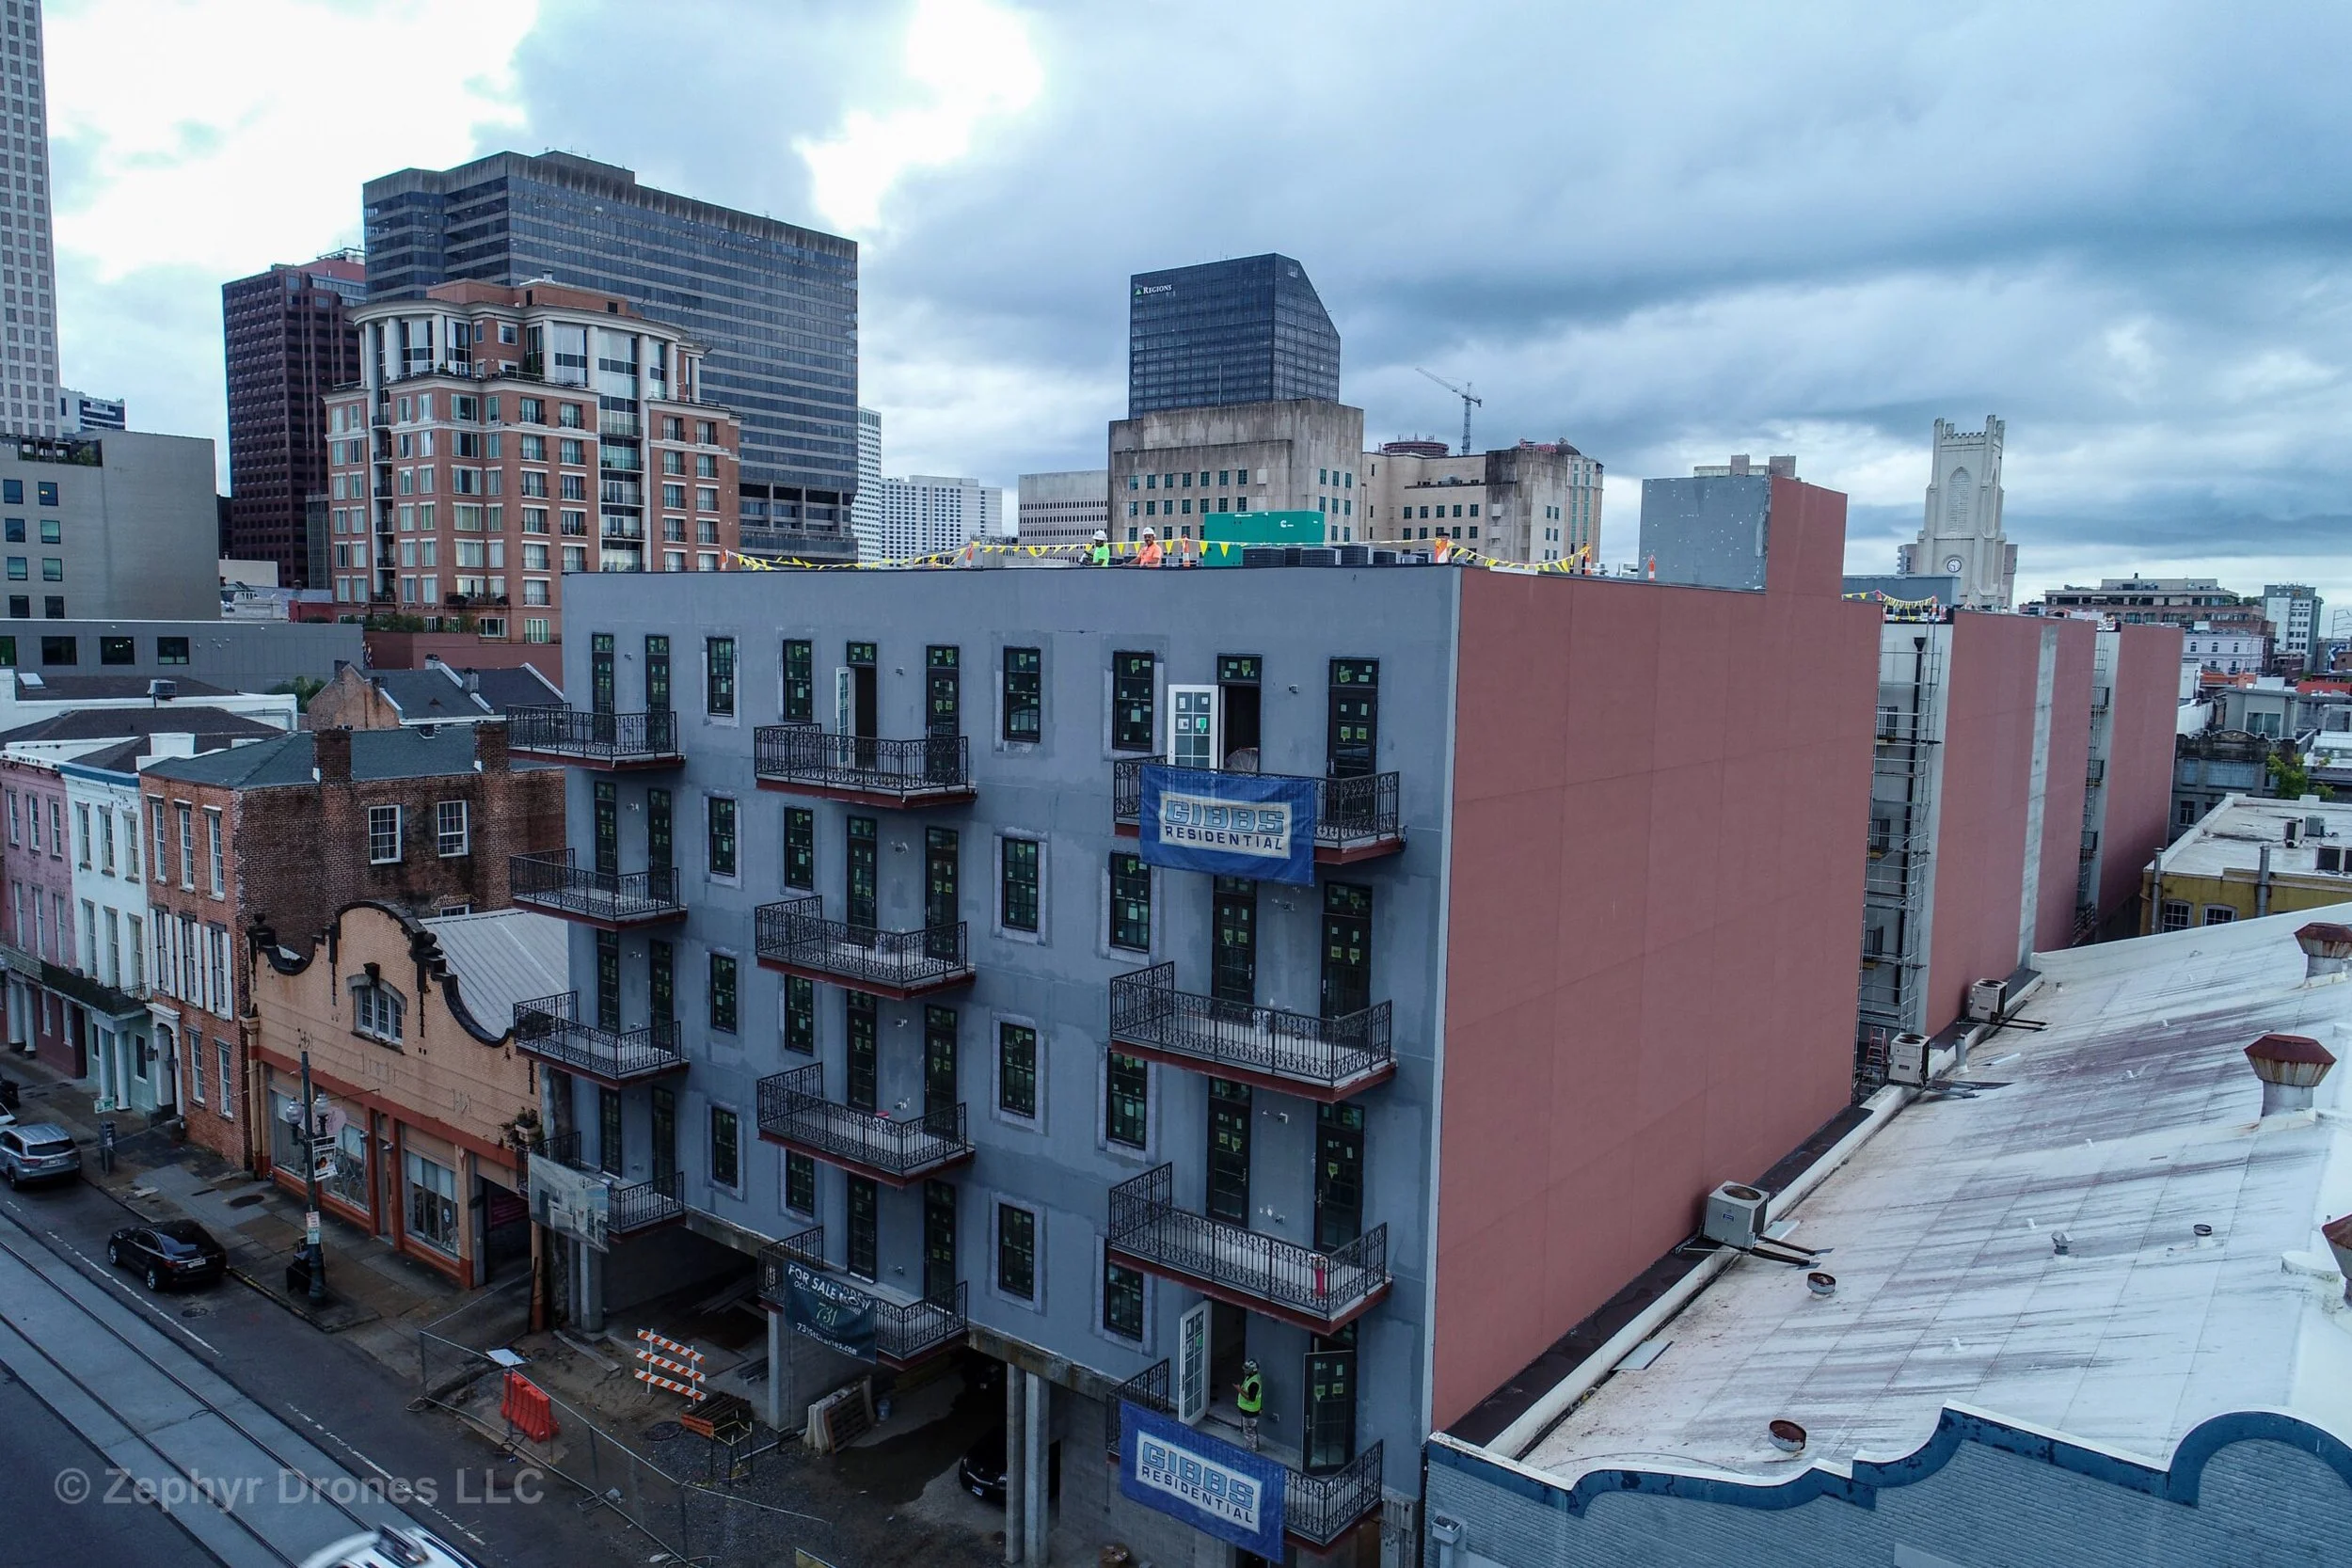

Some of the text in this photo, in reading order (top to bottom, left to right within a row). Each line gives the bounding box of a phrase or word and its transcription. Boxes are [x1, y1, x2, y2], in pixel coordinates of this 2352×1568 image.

[1166, 800, 1284, 833] GIBBS
[1165, 825, 1283, 850] RESIDENTIAL
[788, 1264, 809, 1284] FOR
[812, 1277, 836, 1299] SALE
[838, 1292, 871, 1310] NOW
[816, 1302, 839, 1326] 731
[1141, 1465, 1253, 1524] RESIDENTIAL
[1142, 1441, 1254, 1509] GIBBS
